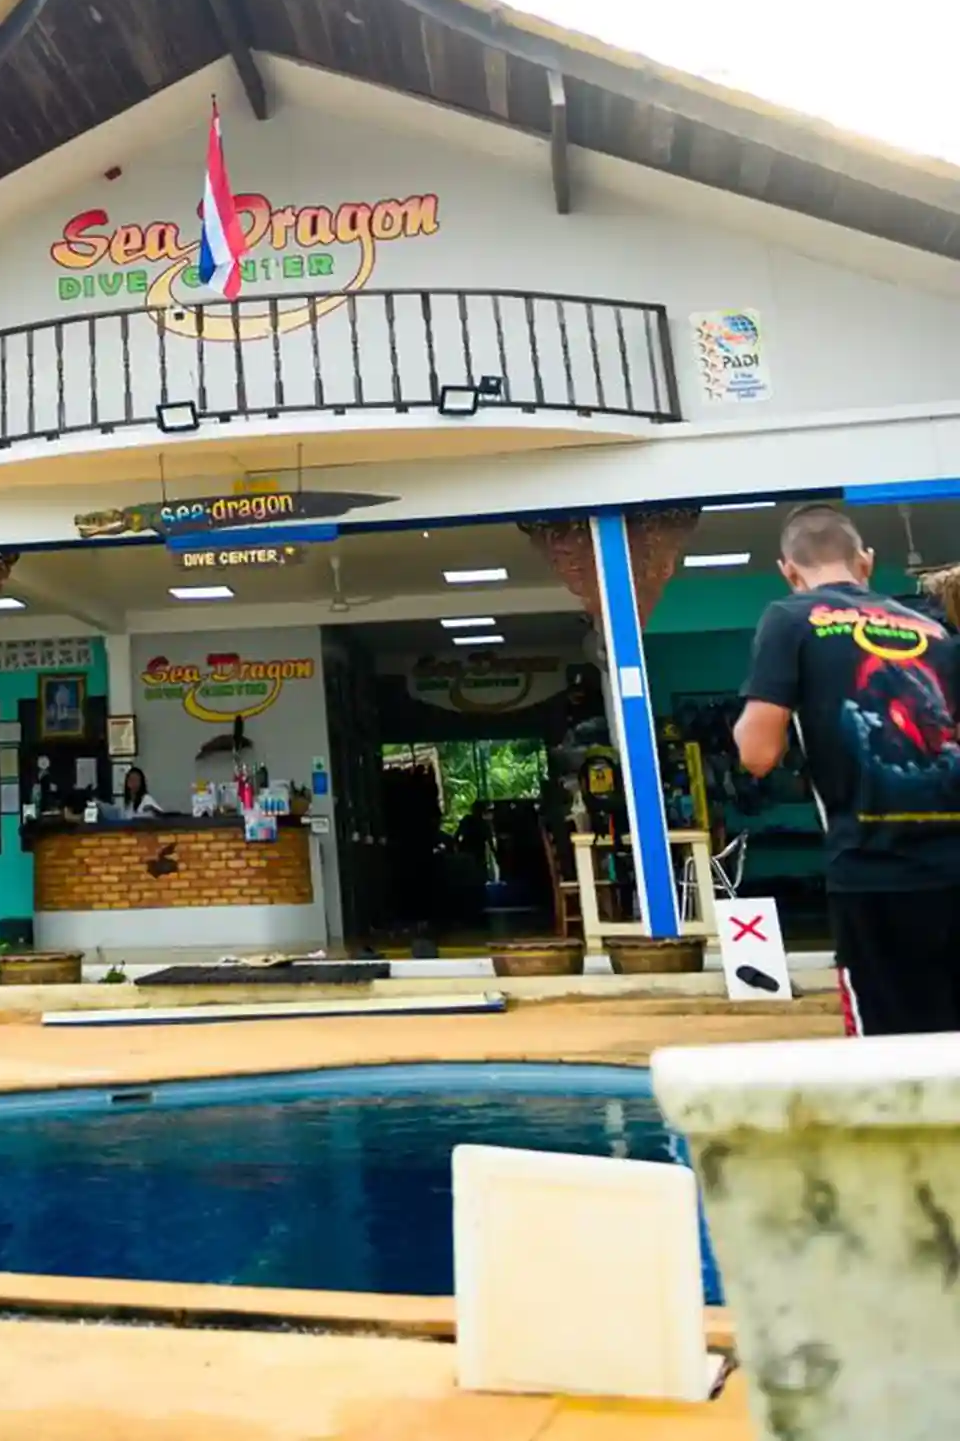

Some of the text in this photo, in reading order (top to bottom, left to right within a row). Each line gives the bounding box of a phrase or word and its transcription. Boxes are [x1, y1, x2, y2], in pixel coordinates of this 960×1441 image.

[50, 208, 190, 269] Sea
[58, 253, 334, 301] DIVE CNTER
[722, 353, 760, 369] PADI
[183, 549, 278, 567] DIVE CENTER
[141, 652, 315, 686] Sea Dragon
